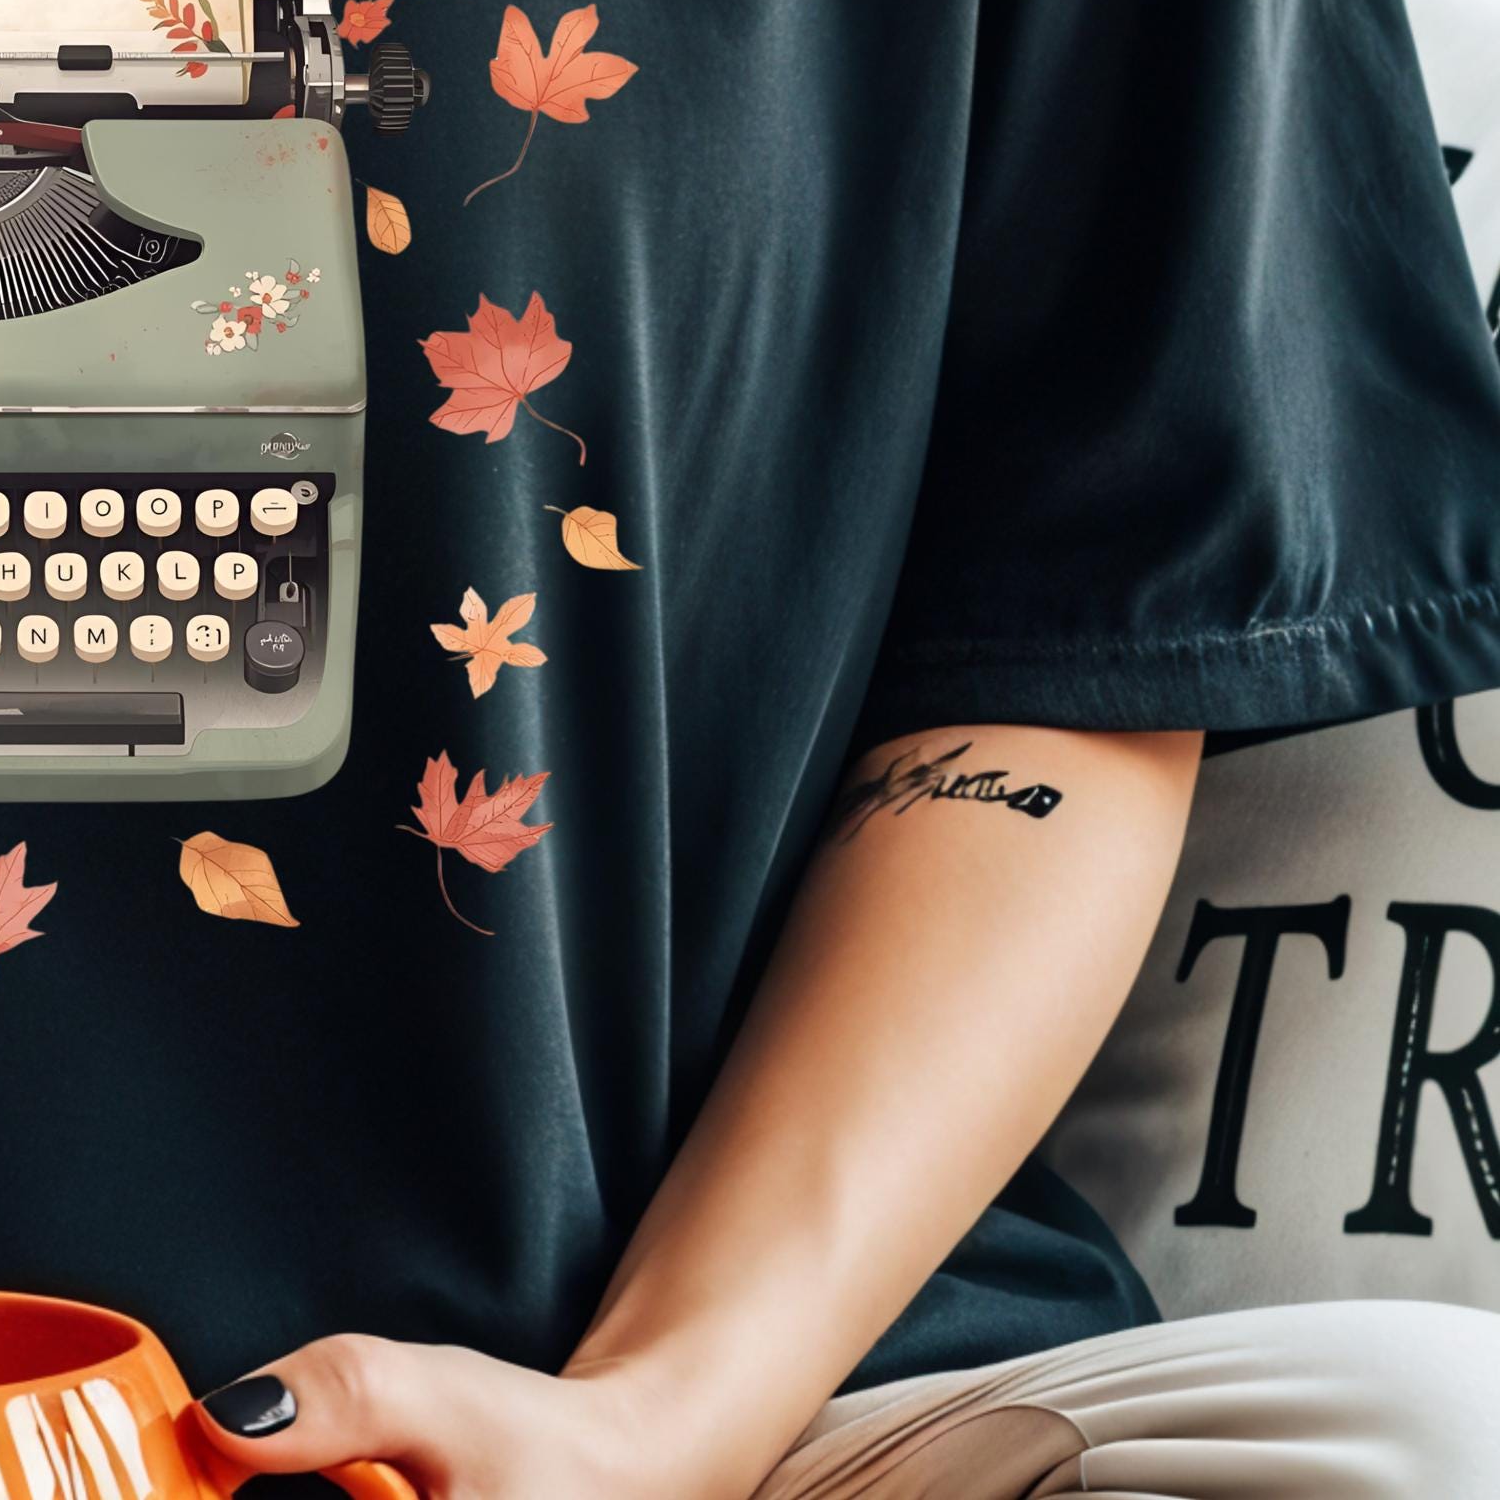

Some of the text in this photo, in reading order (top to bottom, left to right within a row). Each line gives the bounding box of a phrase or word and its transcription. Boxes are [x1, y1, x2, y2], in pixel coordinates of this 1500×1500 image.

[212, 498, 225, 520] P
[1, 563, 17, 581] H
[56, 563, 74, 583] U
[116, 562, 132, 582] K
[174, 561, 188, 581] L
[232, 562, 246, 581] P
[30, 627, 48, 646] N
[86, 627, 107, 646] M
